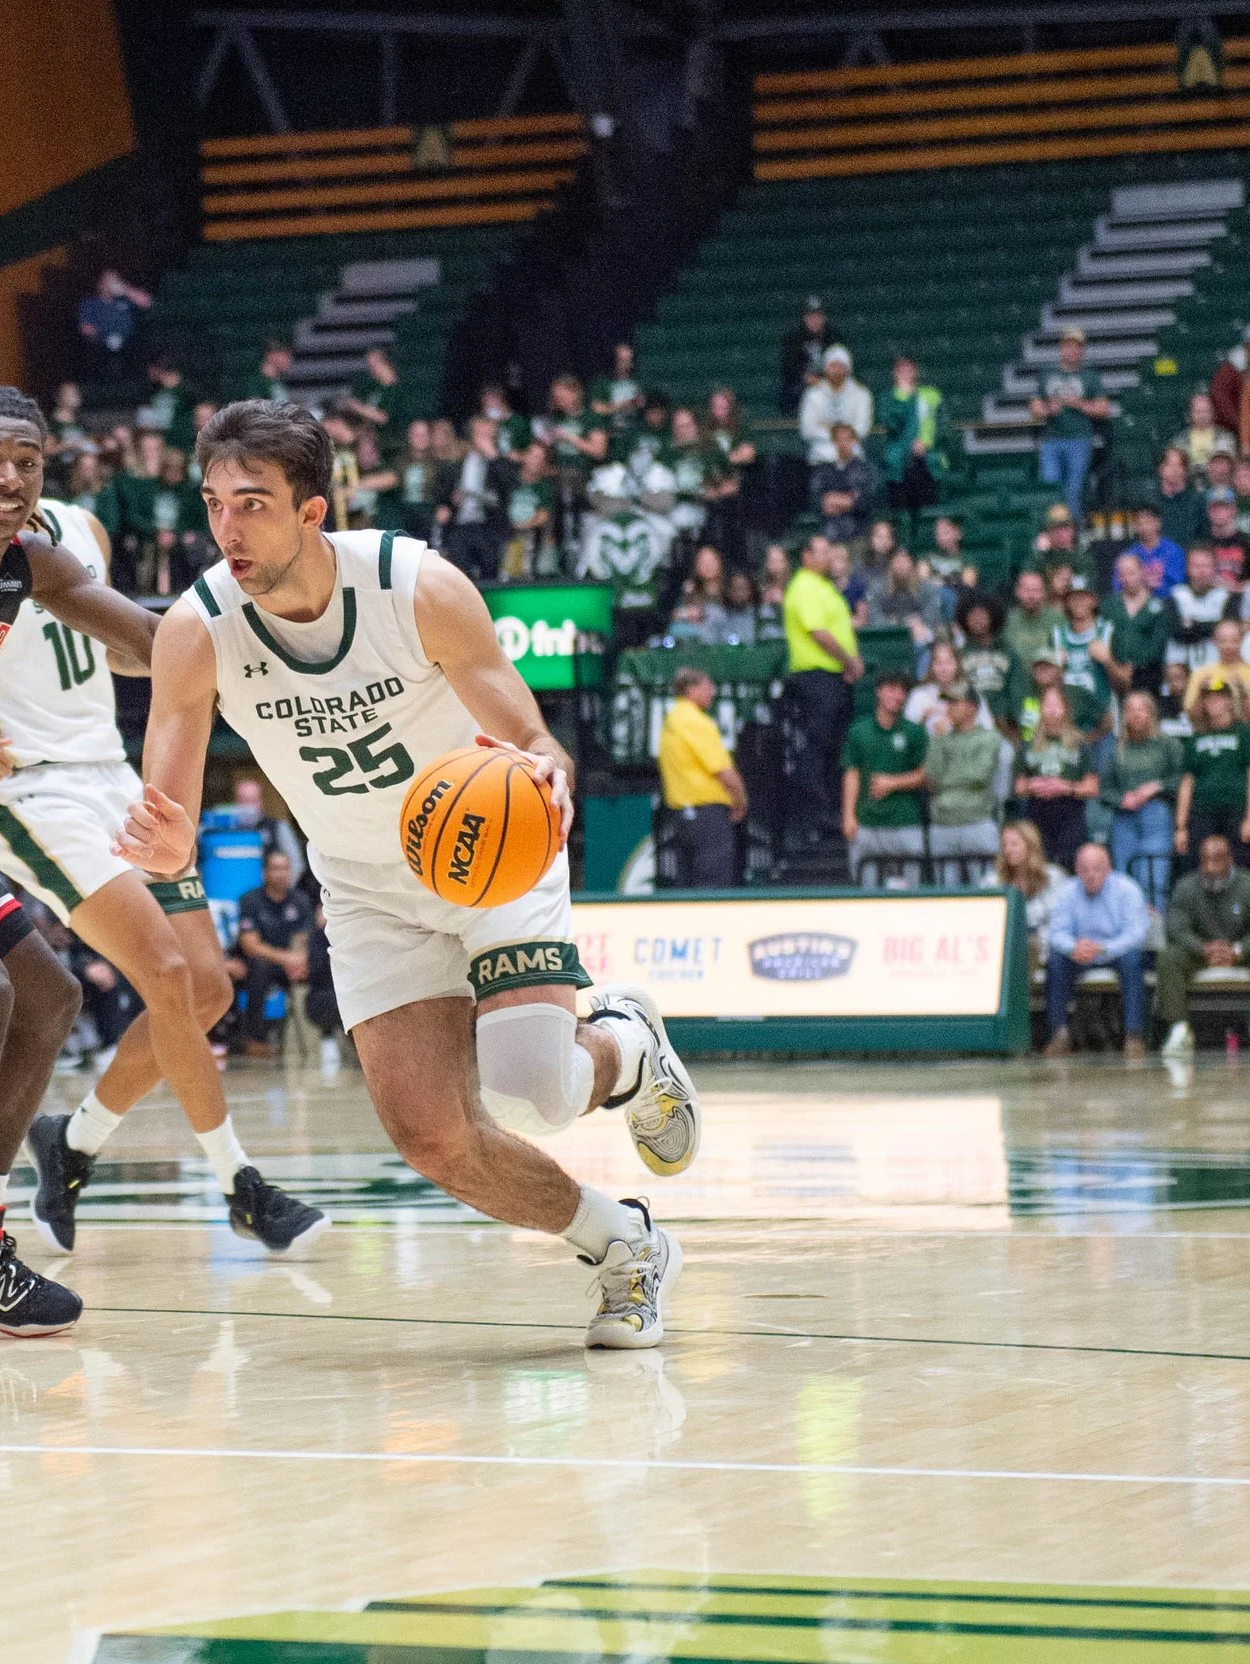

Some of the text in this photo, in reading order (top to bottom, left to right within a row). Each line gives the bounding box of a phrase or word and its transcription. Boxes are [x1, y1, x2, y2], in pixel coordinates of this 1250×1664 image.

[42, 621, 95, 691] 10
[256, 677, 405, 720] COLORADO
[294, 708, 378, 737] STATE
[299, 722, 414, 795] 25
[406, 779, 453, 877] Wilson
[447, 813, 486, 885] NCAA
[178, 880, 207, 900] RA
[478, 948, 563, 984] RAMS
[884, 936, 924, 963] BIG
